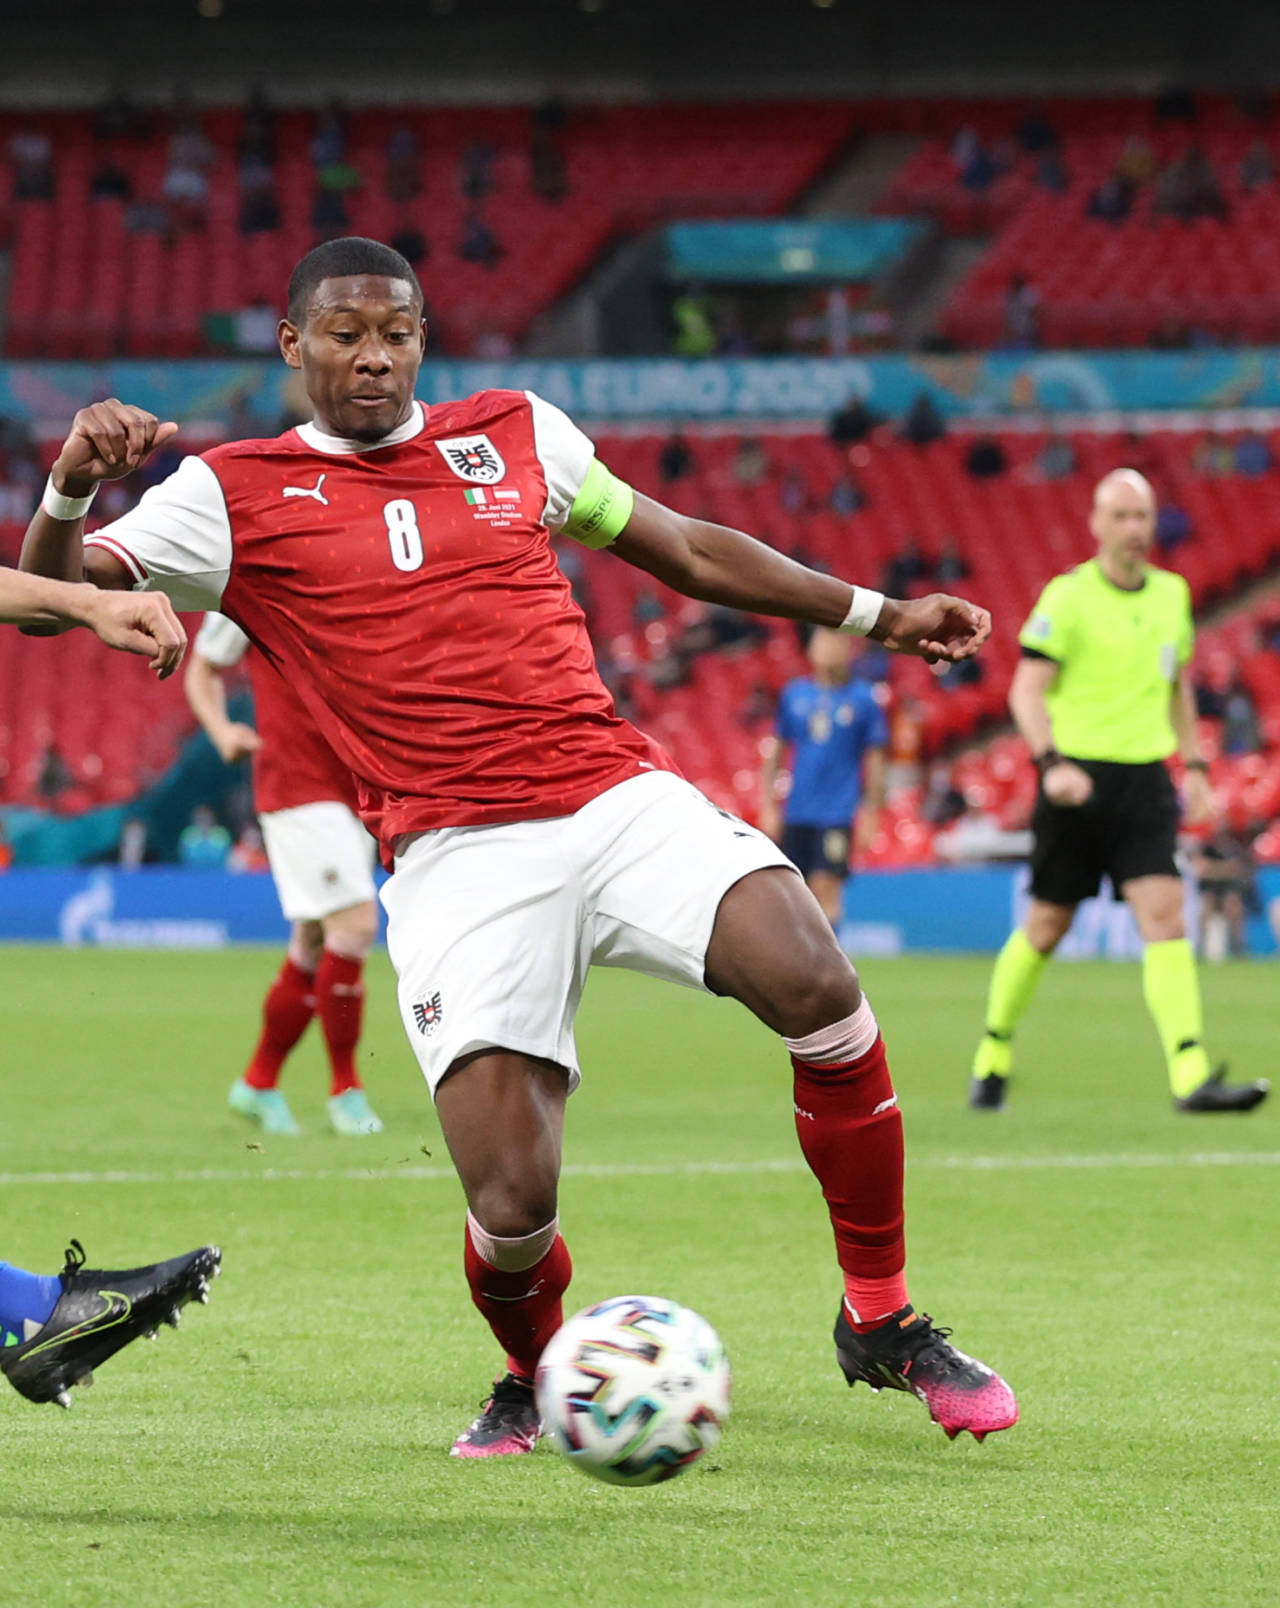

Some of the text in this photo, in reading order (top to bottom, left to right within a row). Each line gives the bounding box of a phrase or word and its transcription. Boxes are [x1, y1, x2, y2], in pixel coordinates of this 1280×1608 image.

[581, 361, 730, 411] EURO
[735, 361, 873, 411] 2020
[580, 483, 614, 531] RESPE
[383, 499, 424, 572] 8
